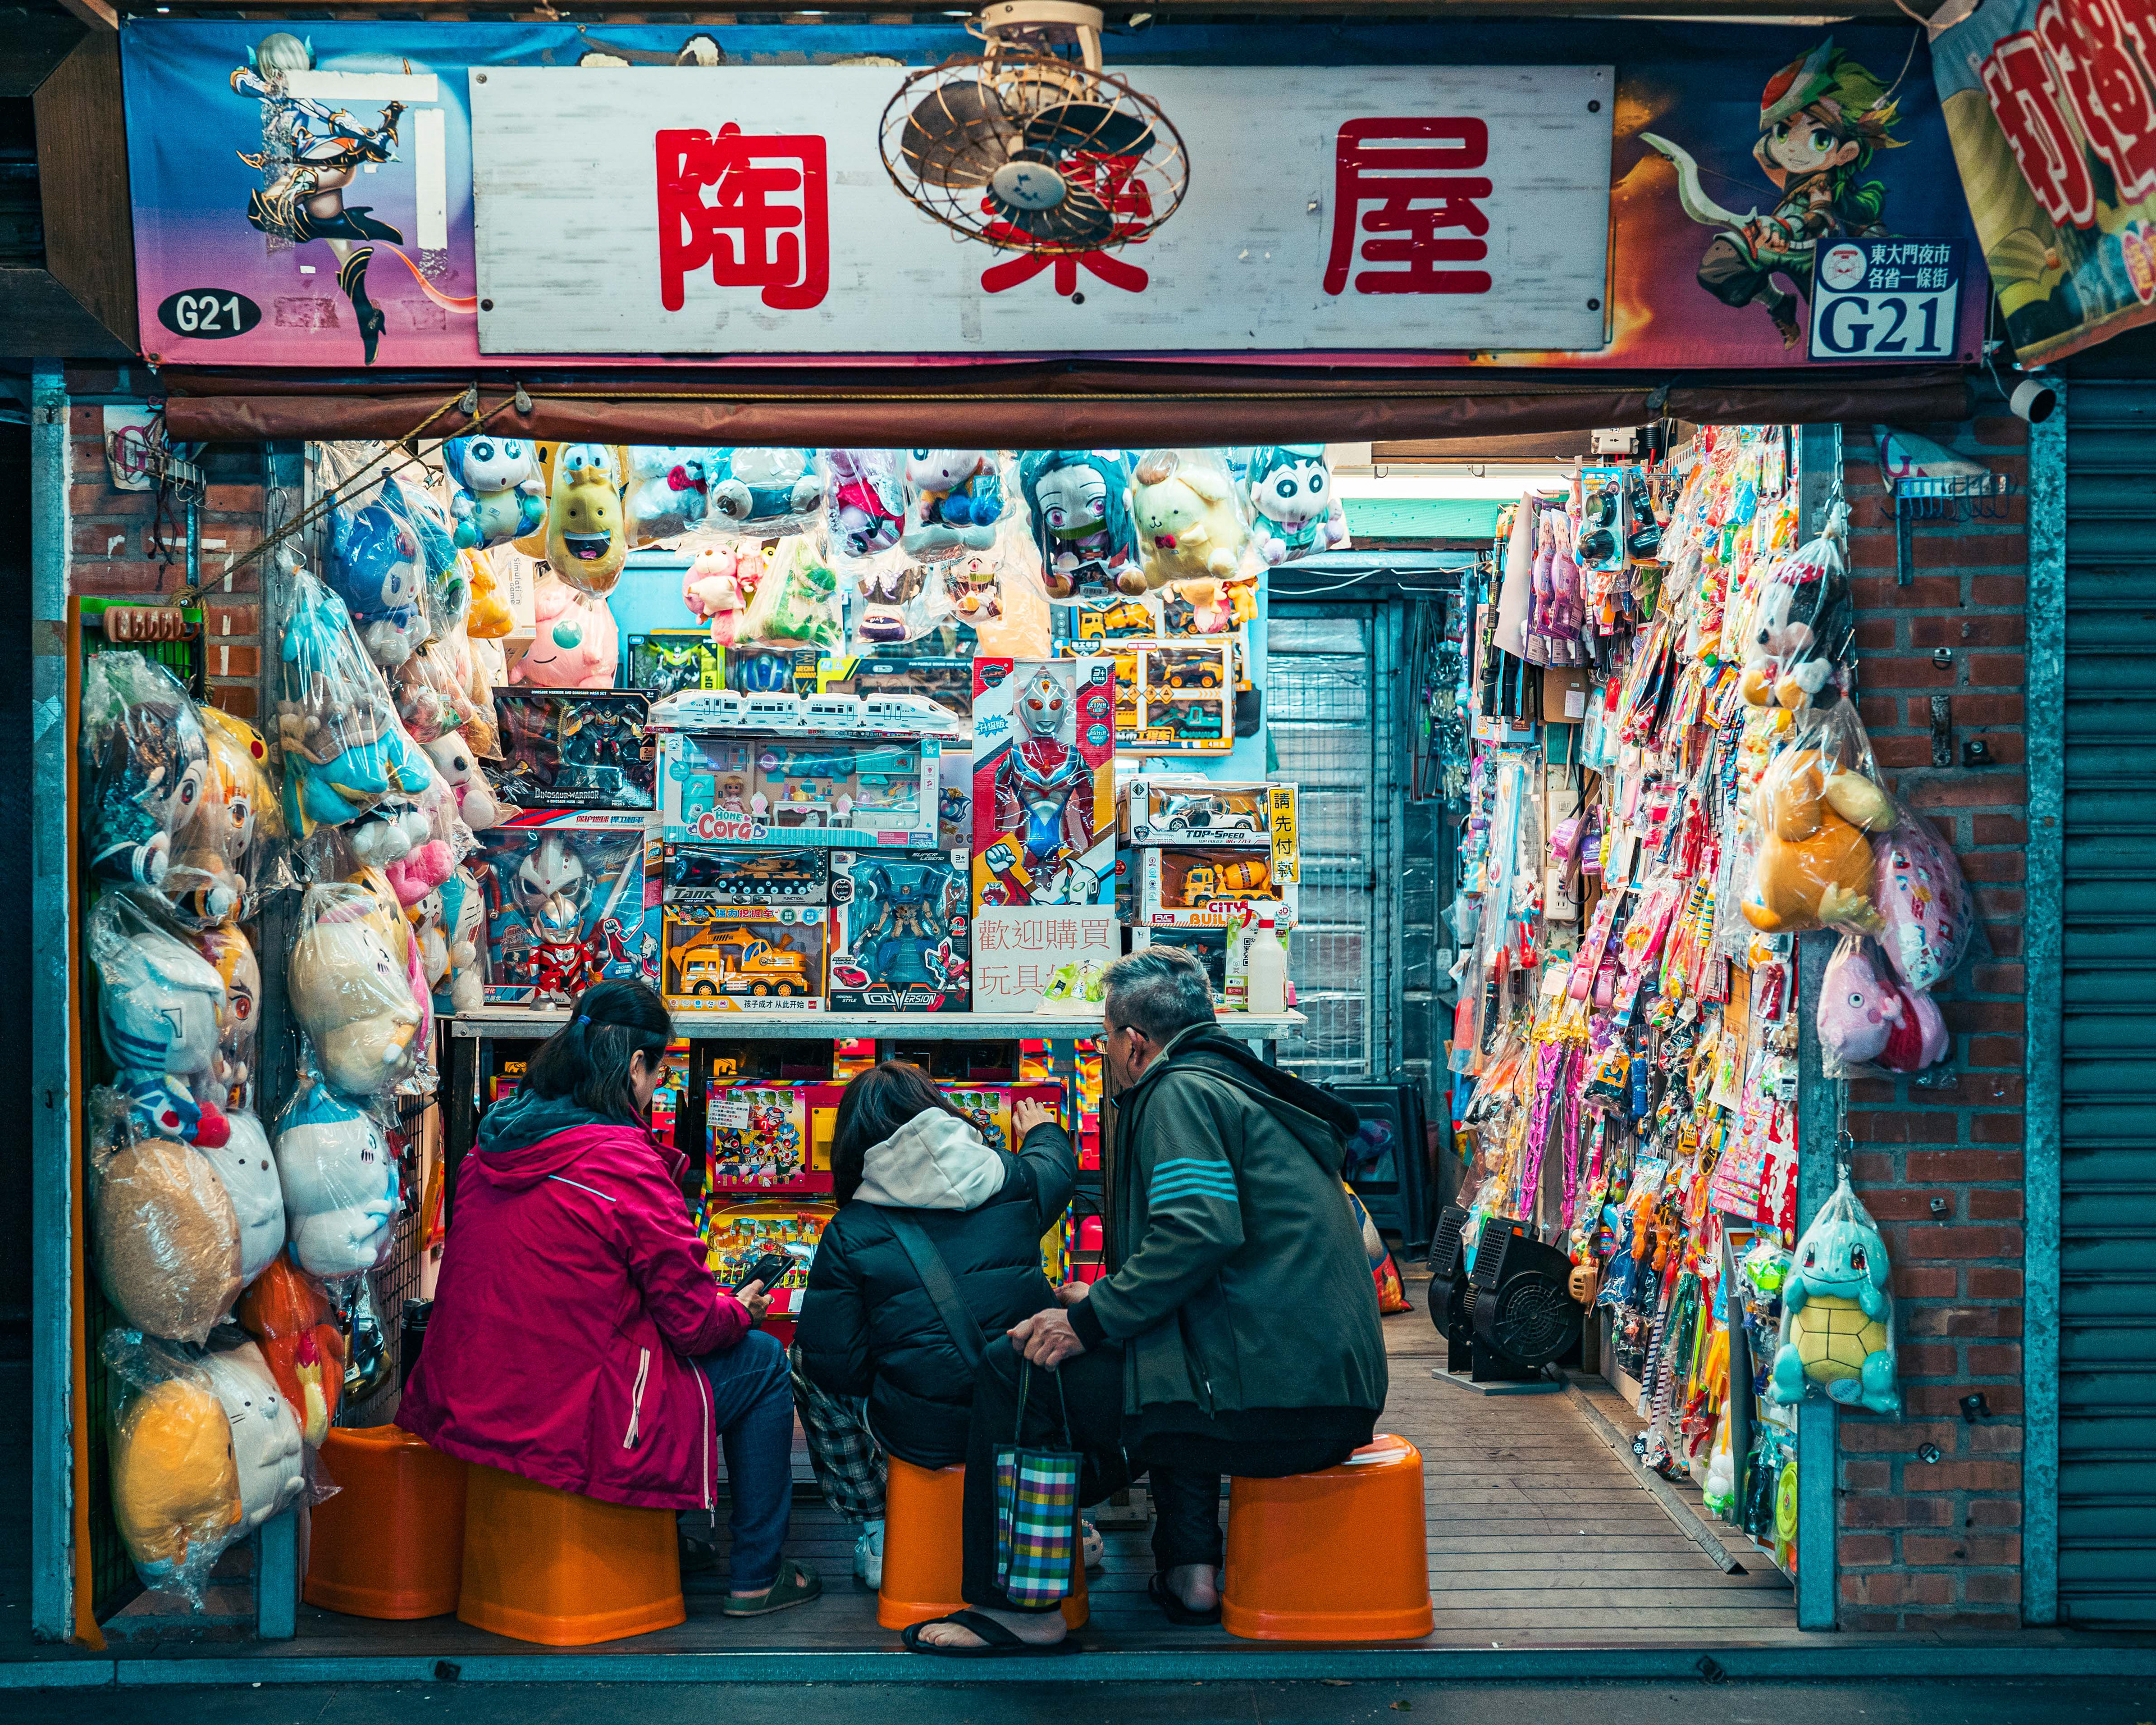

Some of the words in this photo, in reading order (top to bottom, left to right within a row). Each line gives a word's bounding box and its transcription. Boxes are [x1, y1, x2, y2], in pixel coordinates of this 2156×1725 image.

[1871, 244, 1951, 264] 東大門夜市
[1868, 267, 1948, 289] 各省一條街
[175, 295, 241, 331] G21
[1819, 296, 1942, 353] G21
[1093, 668, 1106, 677] 3+
[979, 719, 1006, 732] 升级版
[568, 790, 600, 800] WARRIOR
[715, 810, 743, 822] HOME
[698, 814, 752, 839] Cora
[1273, 792, 1294, 878] 請先付款
[715, 908, 774, 919] 强力挖掘车
[978, 919, 1110, 951] 歡迎購買
[744, 1000, 773, 1008] 孩子成才
[775, 1000, 805, 1008] 从此开始
[761, 1121, 767, 1130] 7
